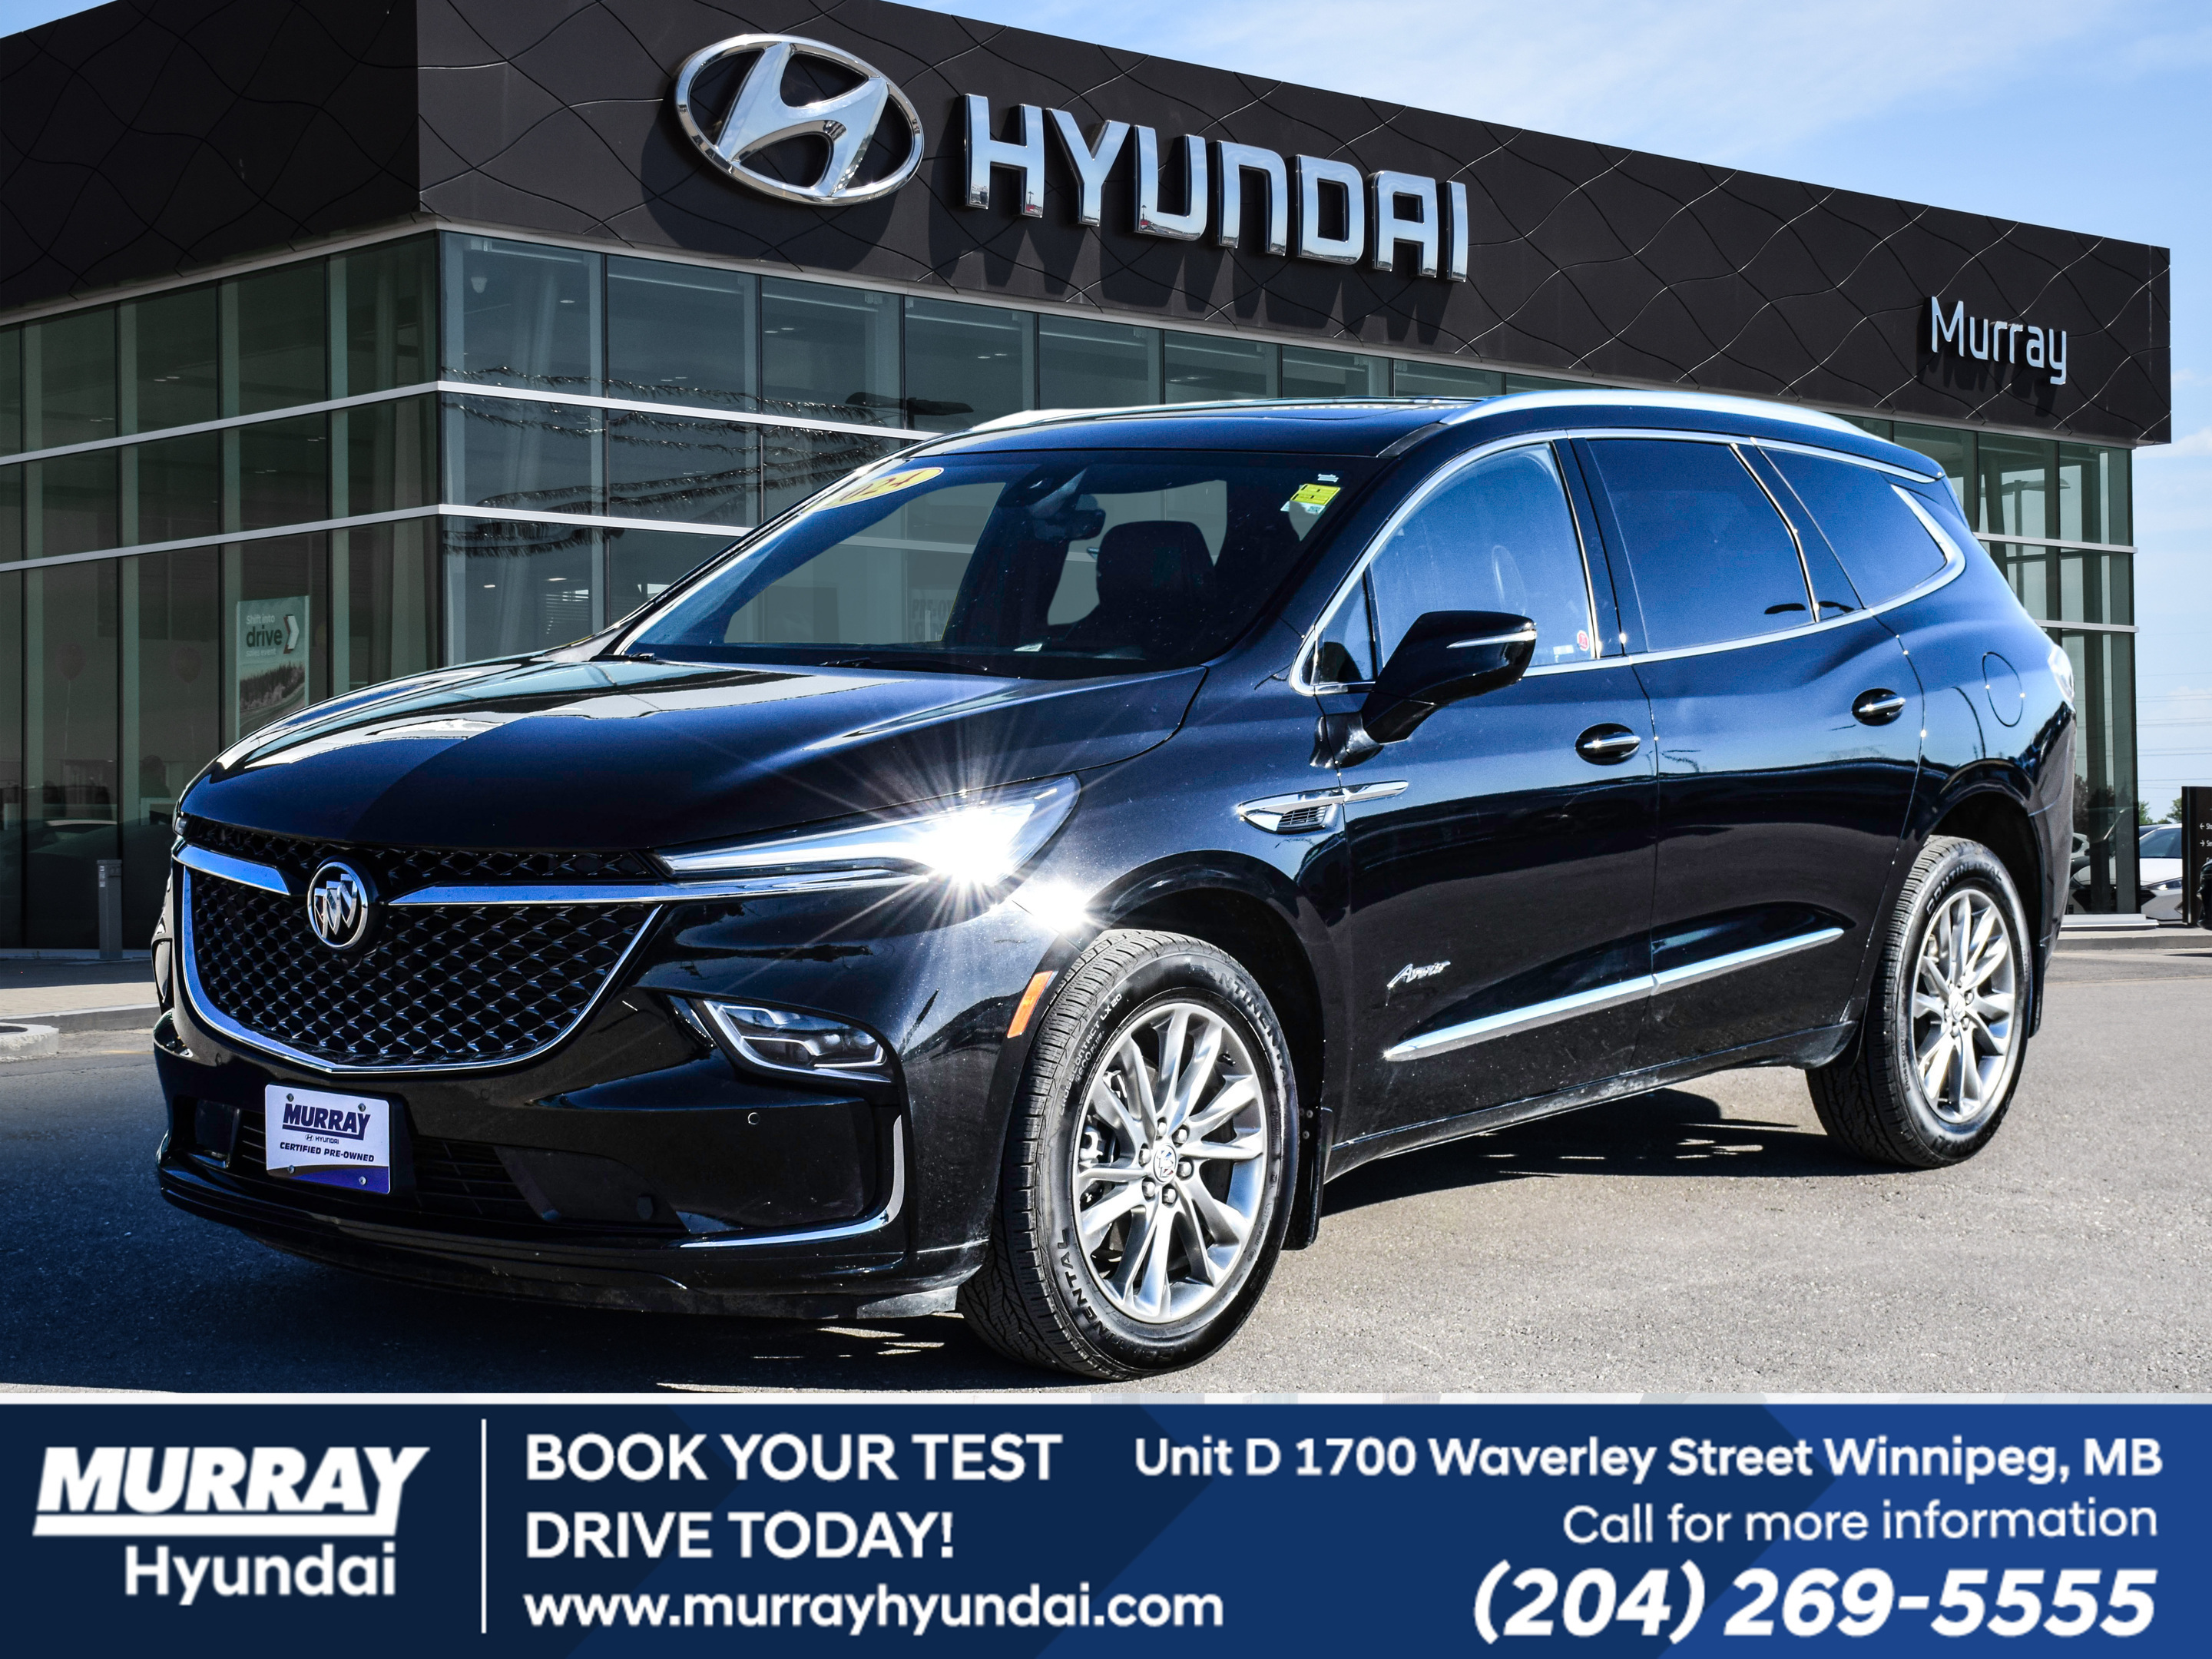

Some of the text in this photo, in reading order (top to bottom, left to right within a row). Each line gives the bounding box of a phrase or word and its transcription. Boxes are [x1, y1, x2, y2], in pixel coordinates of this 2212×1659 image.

[964, 93, 1469, 283] HYUNDAI
[1931, 296, 2067, 385] Murray
[261, 614, 276, 624] into
[246, 624, 283, 647] drive
[282, 1103, 371, 1141] MURRAY
[315, 1135, 339, 1144] HYUNDAI
[280, 1141, 375, 1162] CERTIFIED PRE-OWNED
